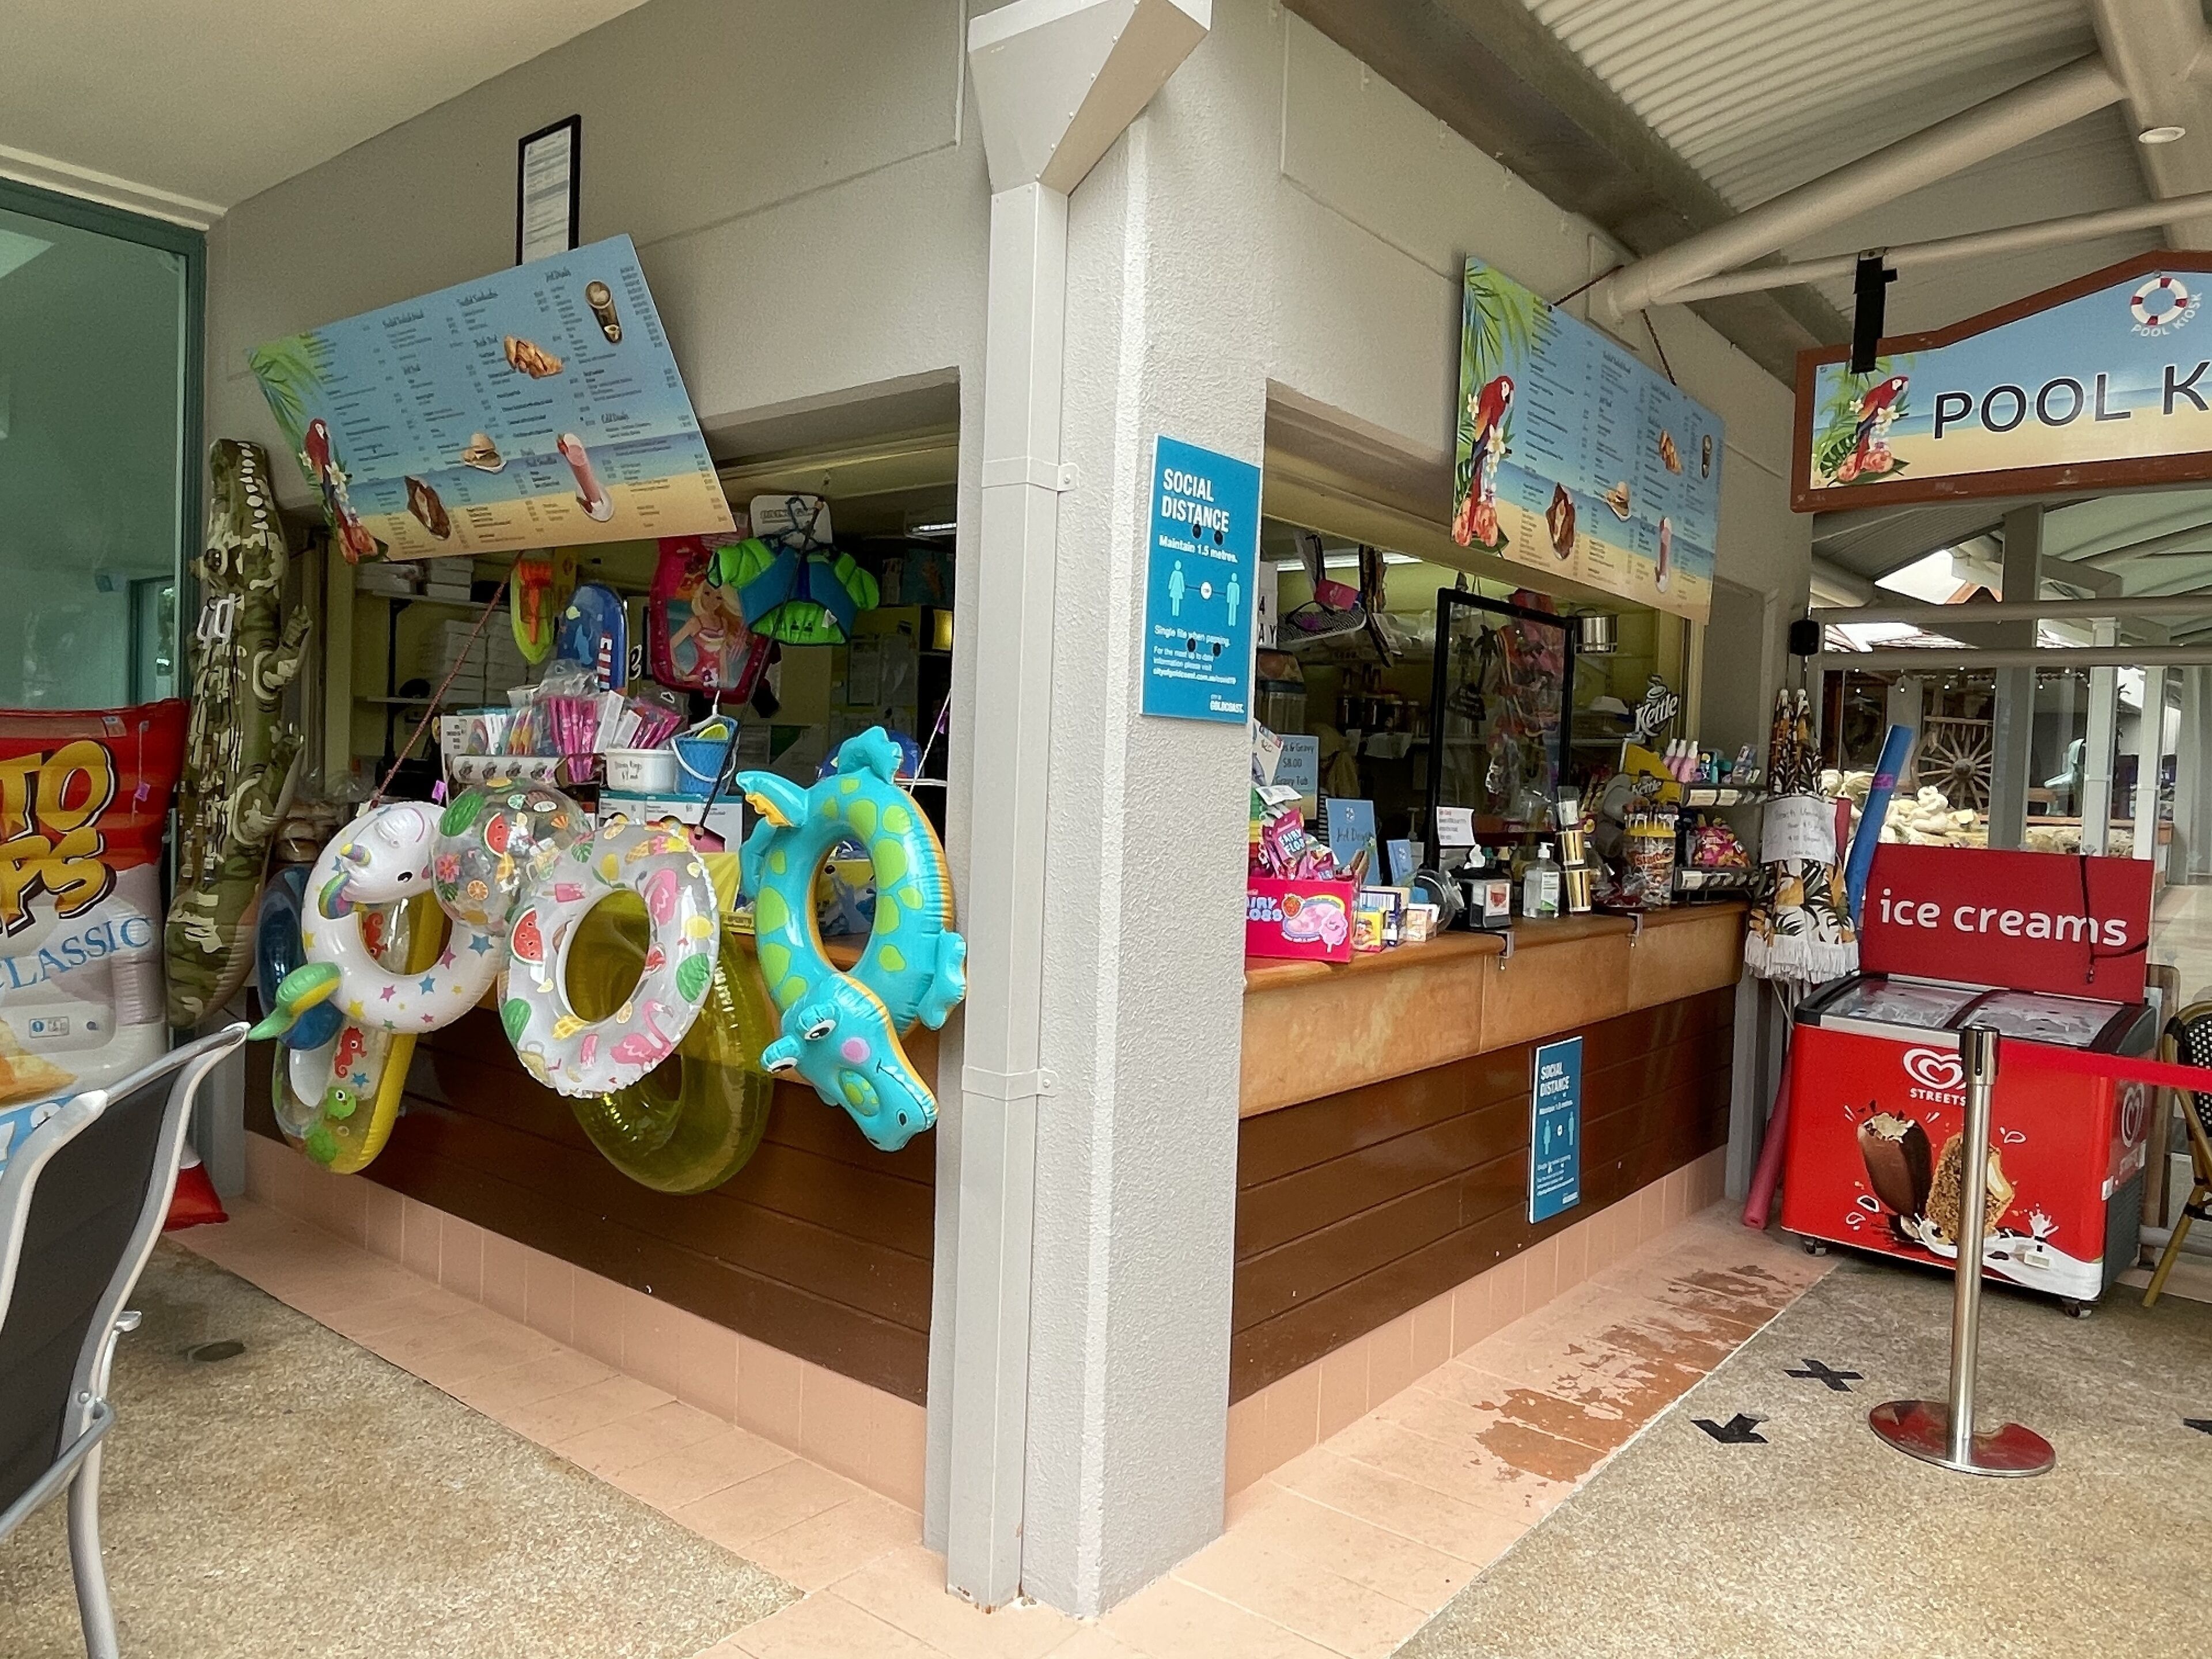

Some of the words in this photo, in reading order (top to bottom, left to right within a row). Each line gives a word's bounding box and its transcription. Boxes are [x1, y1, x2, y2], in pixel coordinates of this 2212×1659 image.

[2131, 324, 2171, 337] POOL
[2172, 292, 2202, 329] KIOSK
[1934, 373, 2131, 439] POOL
[1163, 468, 1214, 502] SOCIAL
[1161, 495, 1229, 532] DISTANCE
[1159, 535, 1195, 553] Maintain
[1197, 544, 1209, 556] 1.5
[1635, 693, 1678, 737] Kettle
[1283, 757, 1302, 768] $8.00
[1278, 828, 1301, 846] FAIRY
[1880, 888, 1940, 928] ice
[1953, 905, 2127, 946] creams
[0, 918, 151, 990] LASSIC
[1910, 1088, 1967, 1106] STREETS
